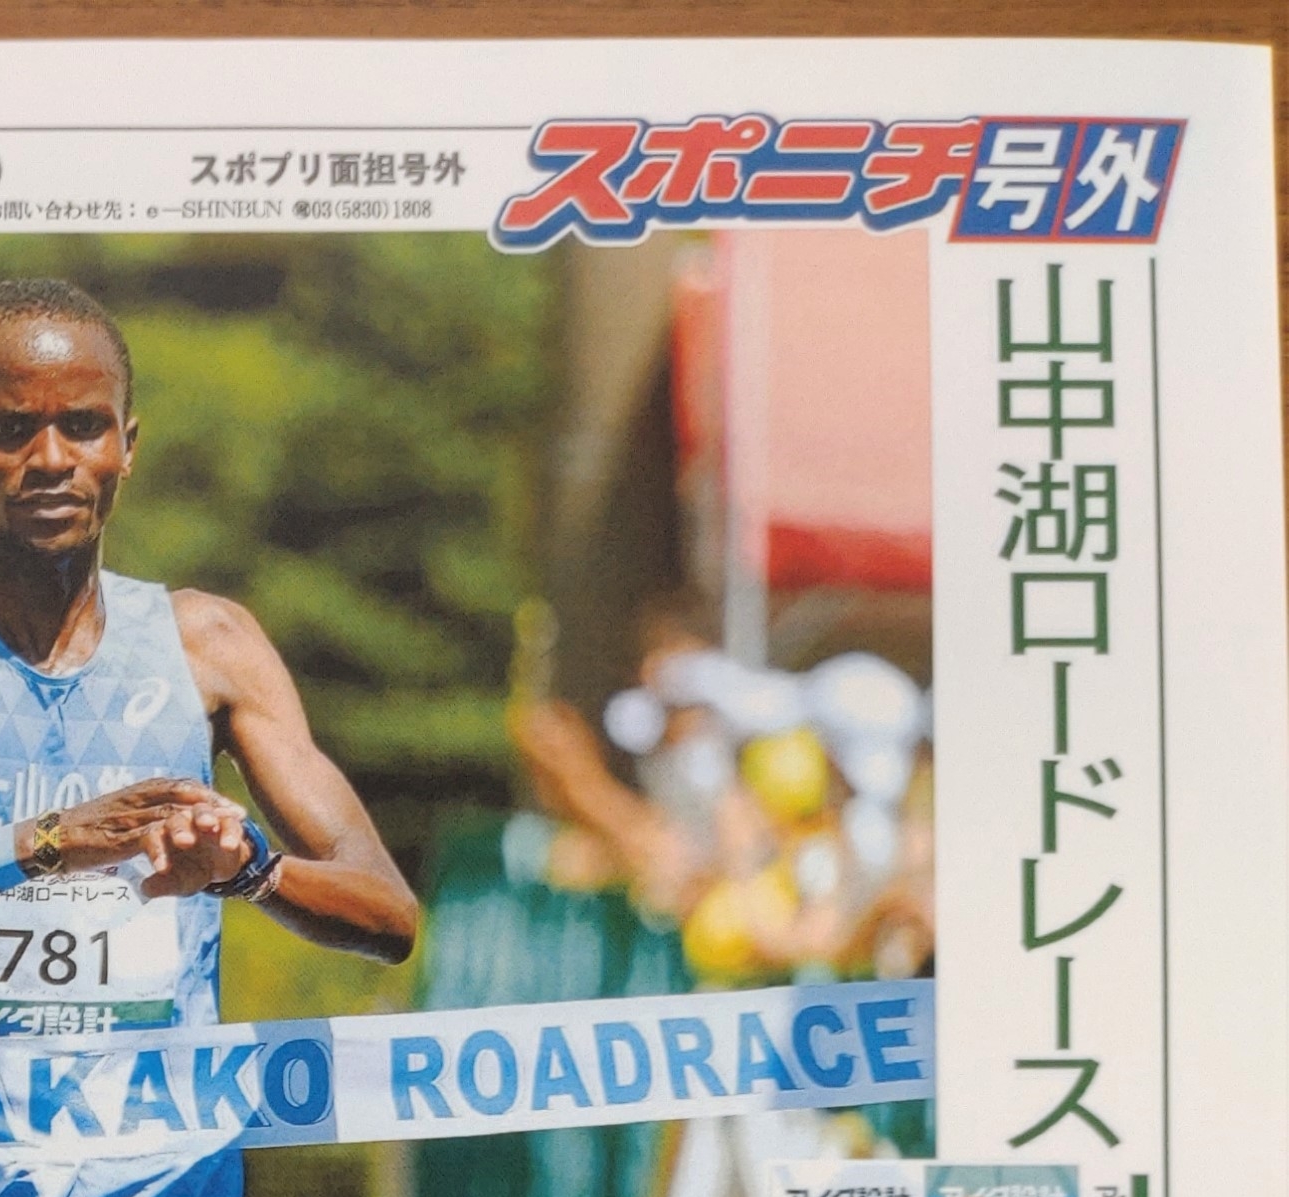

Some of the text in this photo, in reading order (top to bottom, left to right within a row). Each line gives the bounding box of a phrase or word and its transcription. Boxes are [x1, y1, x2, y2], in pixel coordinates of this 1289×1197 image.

[189, 152, 467, 187] スポプリ面担号外
[501, 121, 1160, 232] スポニチ 号外
[994, 262, 1125, 1150] 山中湖ロードレース
[390, 998, 926, 1121] ROADRACE
